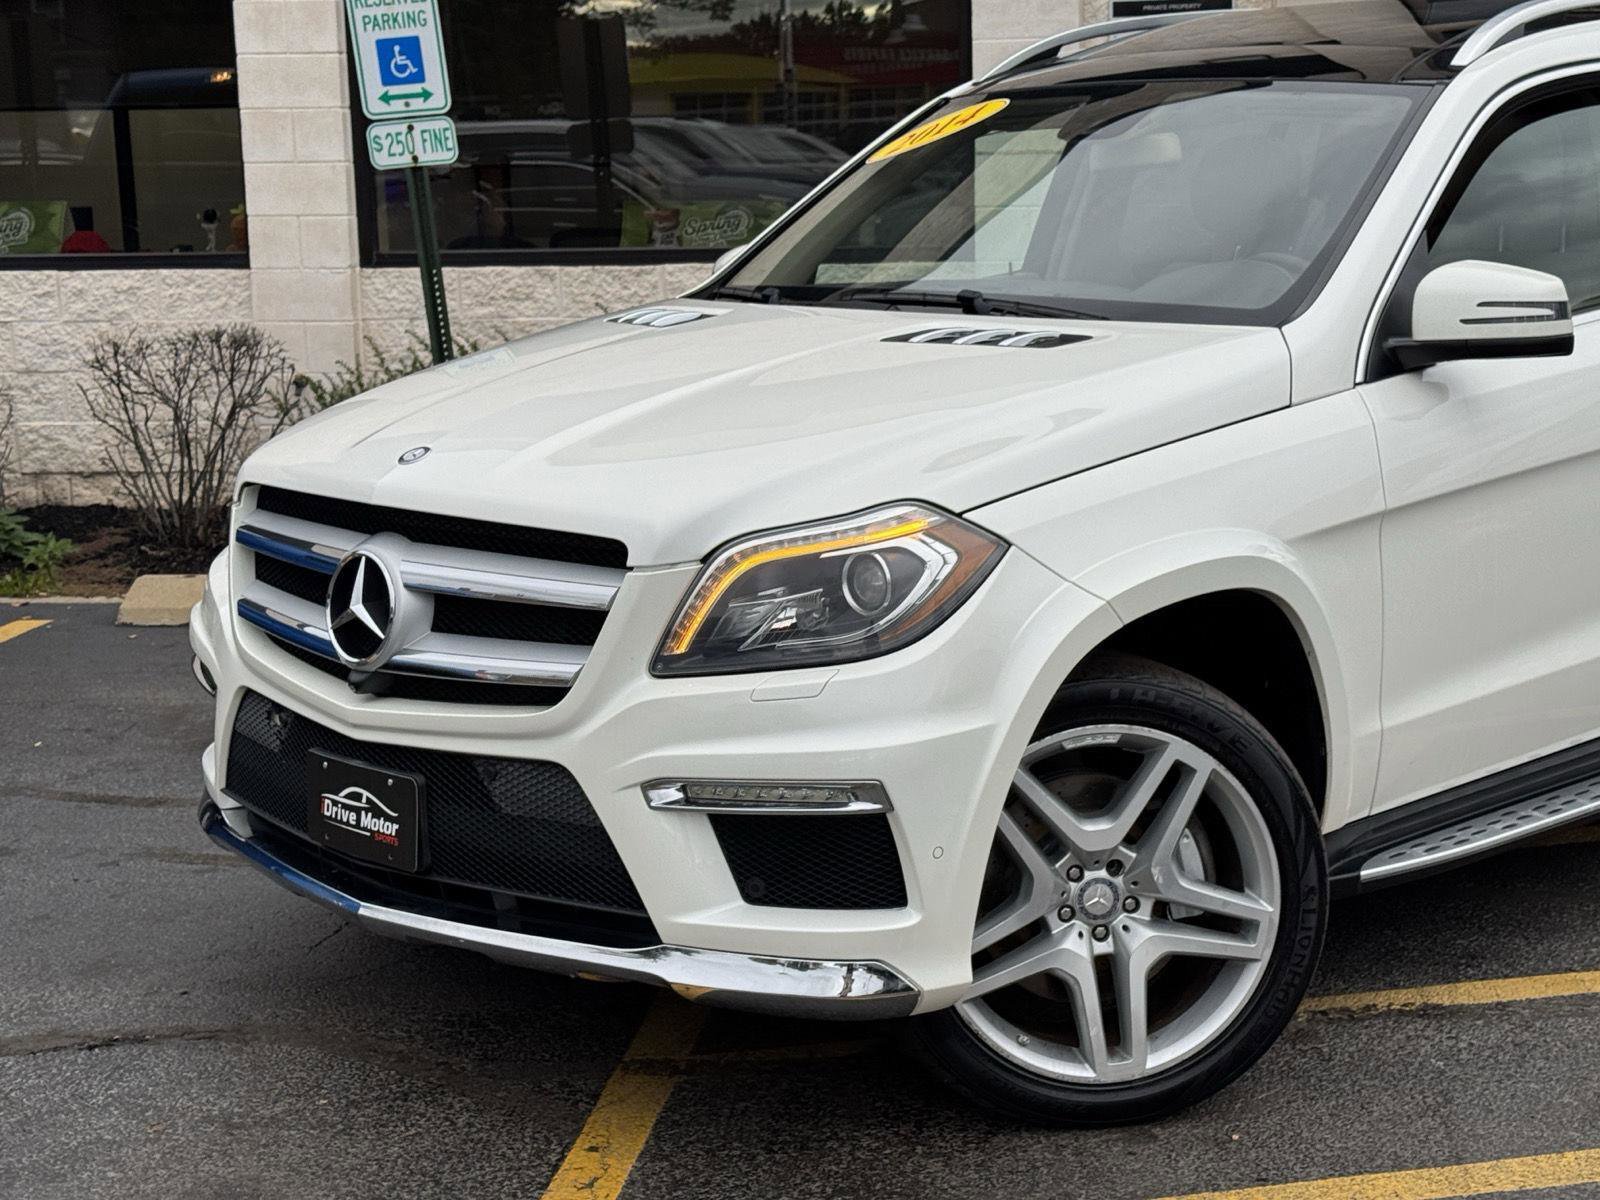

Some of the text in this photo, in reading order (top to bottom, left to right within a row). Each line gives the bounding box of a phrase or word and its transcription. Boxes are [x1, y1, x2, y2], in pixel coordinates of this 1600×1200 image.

[362, 10, 427, 32] PARKING
[420, 127, 453, 154] FINE
[360, 810, 399, 836] Motor
